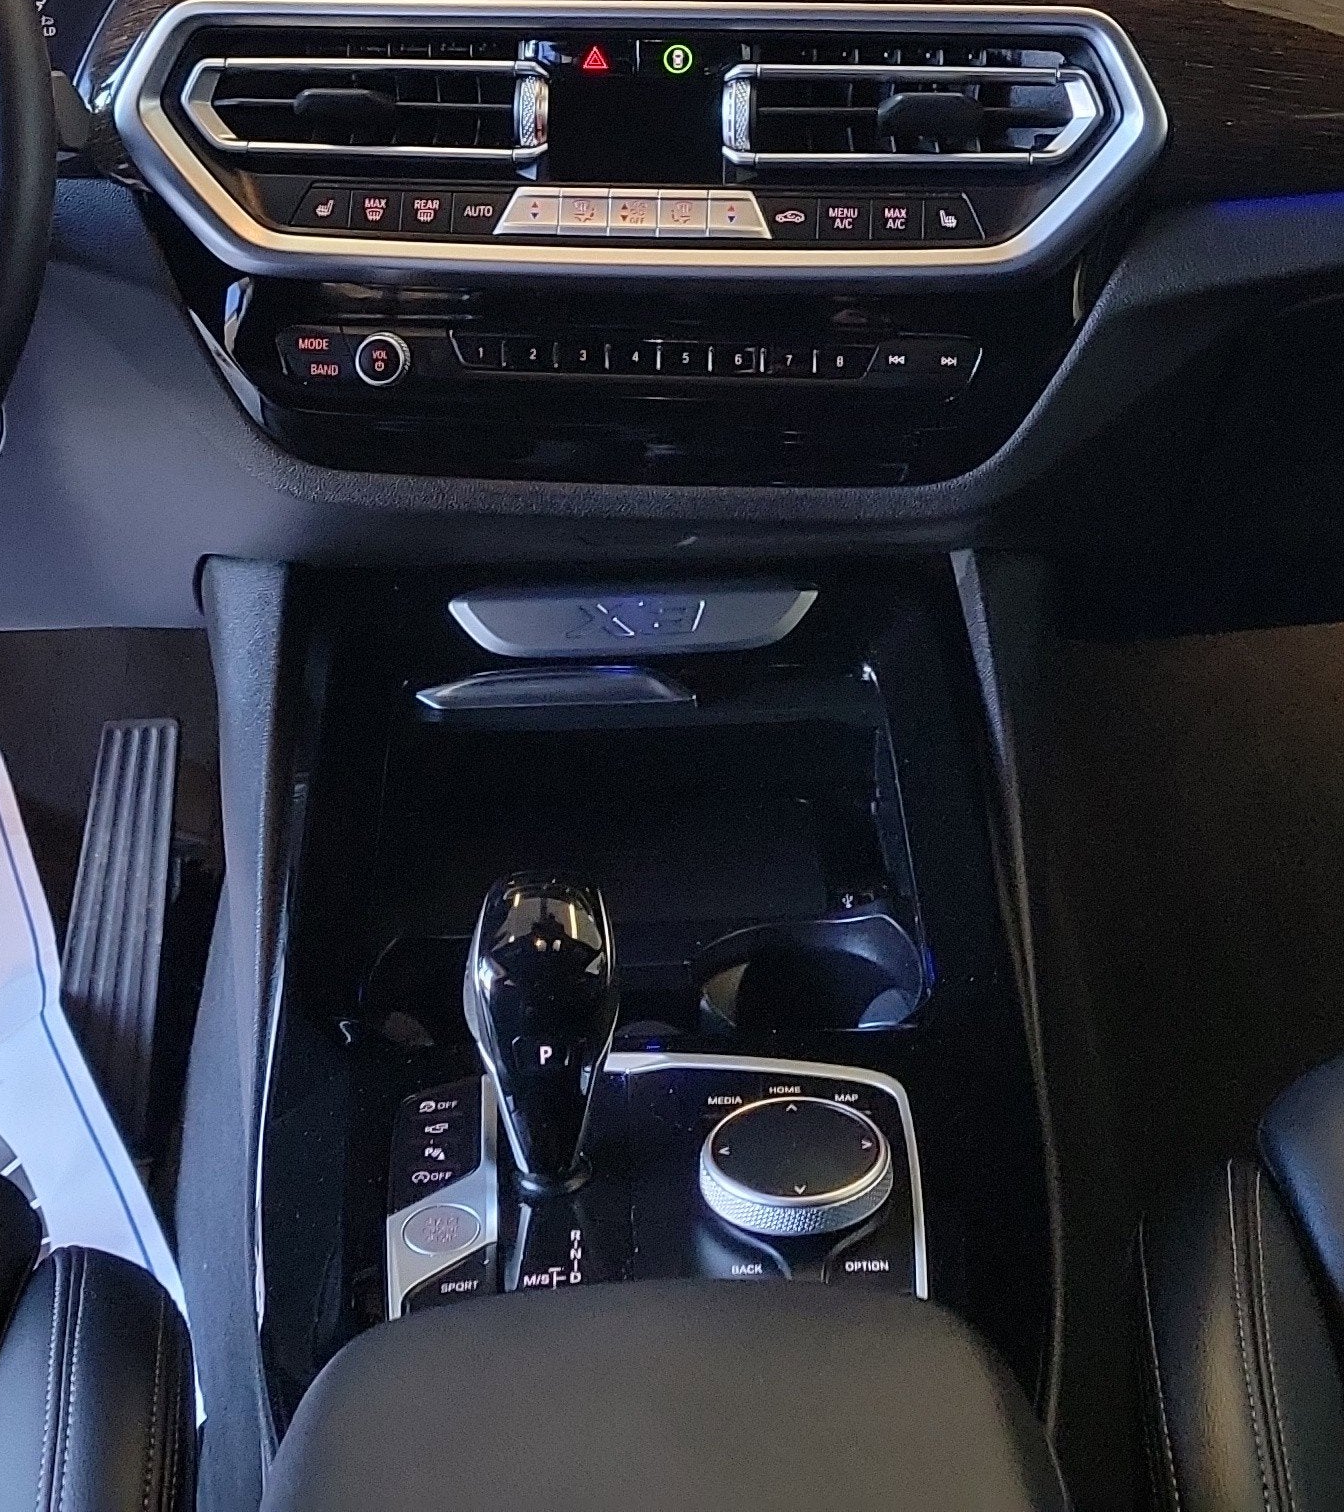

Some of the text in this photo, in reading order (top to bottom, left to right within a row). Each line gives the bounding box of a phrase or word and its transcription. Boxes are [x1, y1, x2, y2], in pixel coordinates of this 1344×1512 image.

[364, 198, 388, 209] MAX
[413, 199, 440, 210] REAR
[463, 205, 493, 218] AUTO
[828, 207, 858, 219] MENU
[884, 207, 907, 219] MAX
[833, 218, 853, 230] A/C
[886, 218, 906, 230] A/C
[298, 337, 330, 350] MODE
[372, 349, 388, 360] VOL
[478, 347, 484, 359] 1
[529, 348, 537, 360] 2
[579, 349, 587, 361] 3
[632, 351, 639, 363] 4
[682, 352, 690, 364] 5
[734, 354, 743, 365] 6
[785, 354, 793, 366] 7
[836, 355, 844, 367] 8
[310, 363, 339, 376] BAND
[539, 1045, 553, 1065] P
[768, 1085, 801, 1094] HOME
[707, 1095, 743, 1105] MEDIA
[834, 1093, 859, 1103] MAP
[437, 1100, 458, 1110] OFF
[430, 1171, 453, 1181] OFF
[570, 1230, 581, 1240] R
[570, 1249, 582, 1260] N
[731, 1264, 763, 1275] BACK
[844, 1261, 890, 1272] OPTION
[570, 1272, 582, 1284] D
[440, 1279, 479, 1294] SPORT
